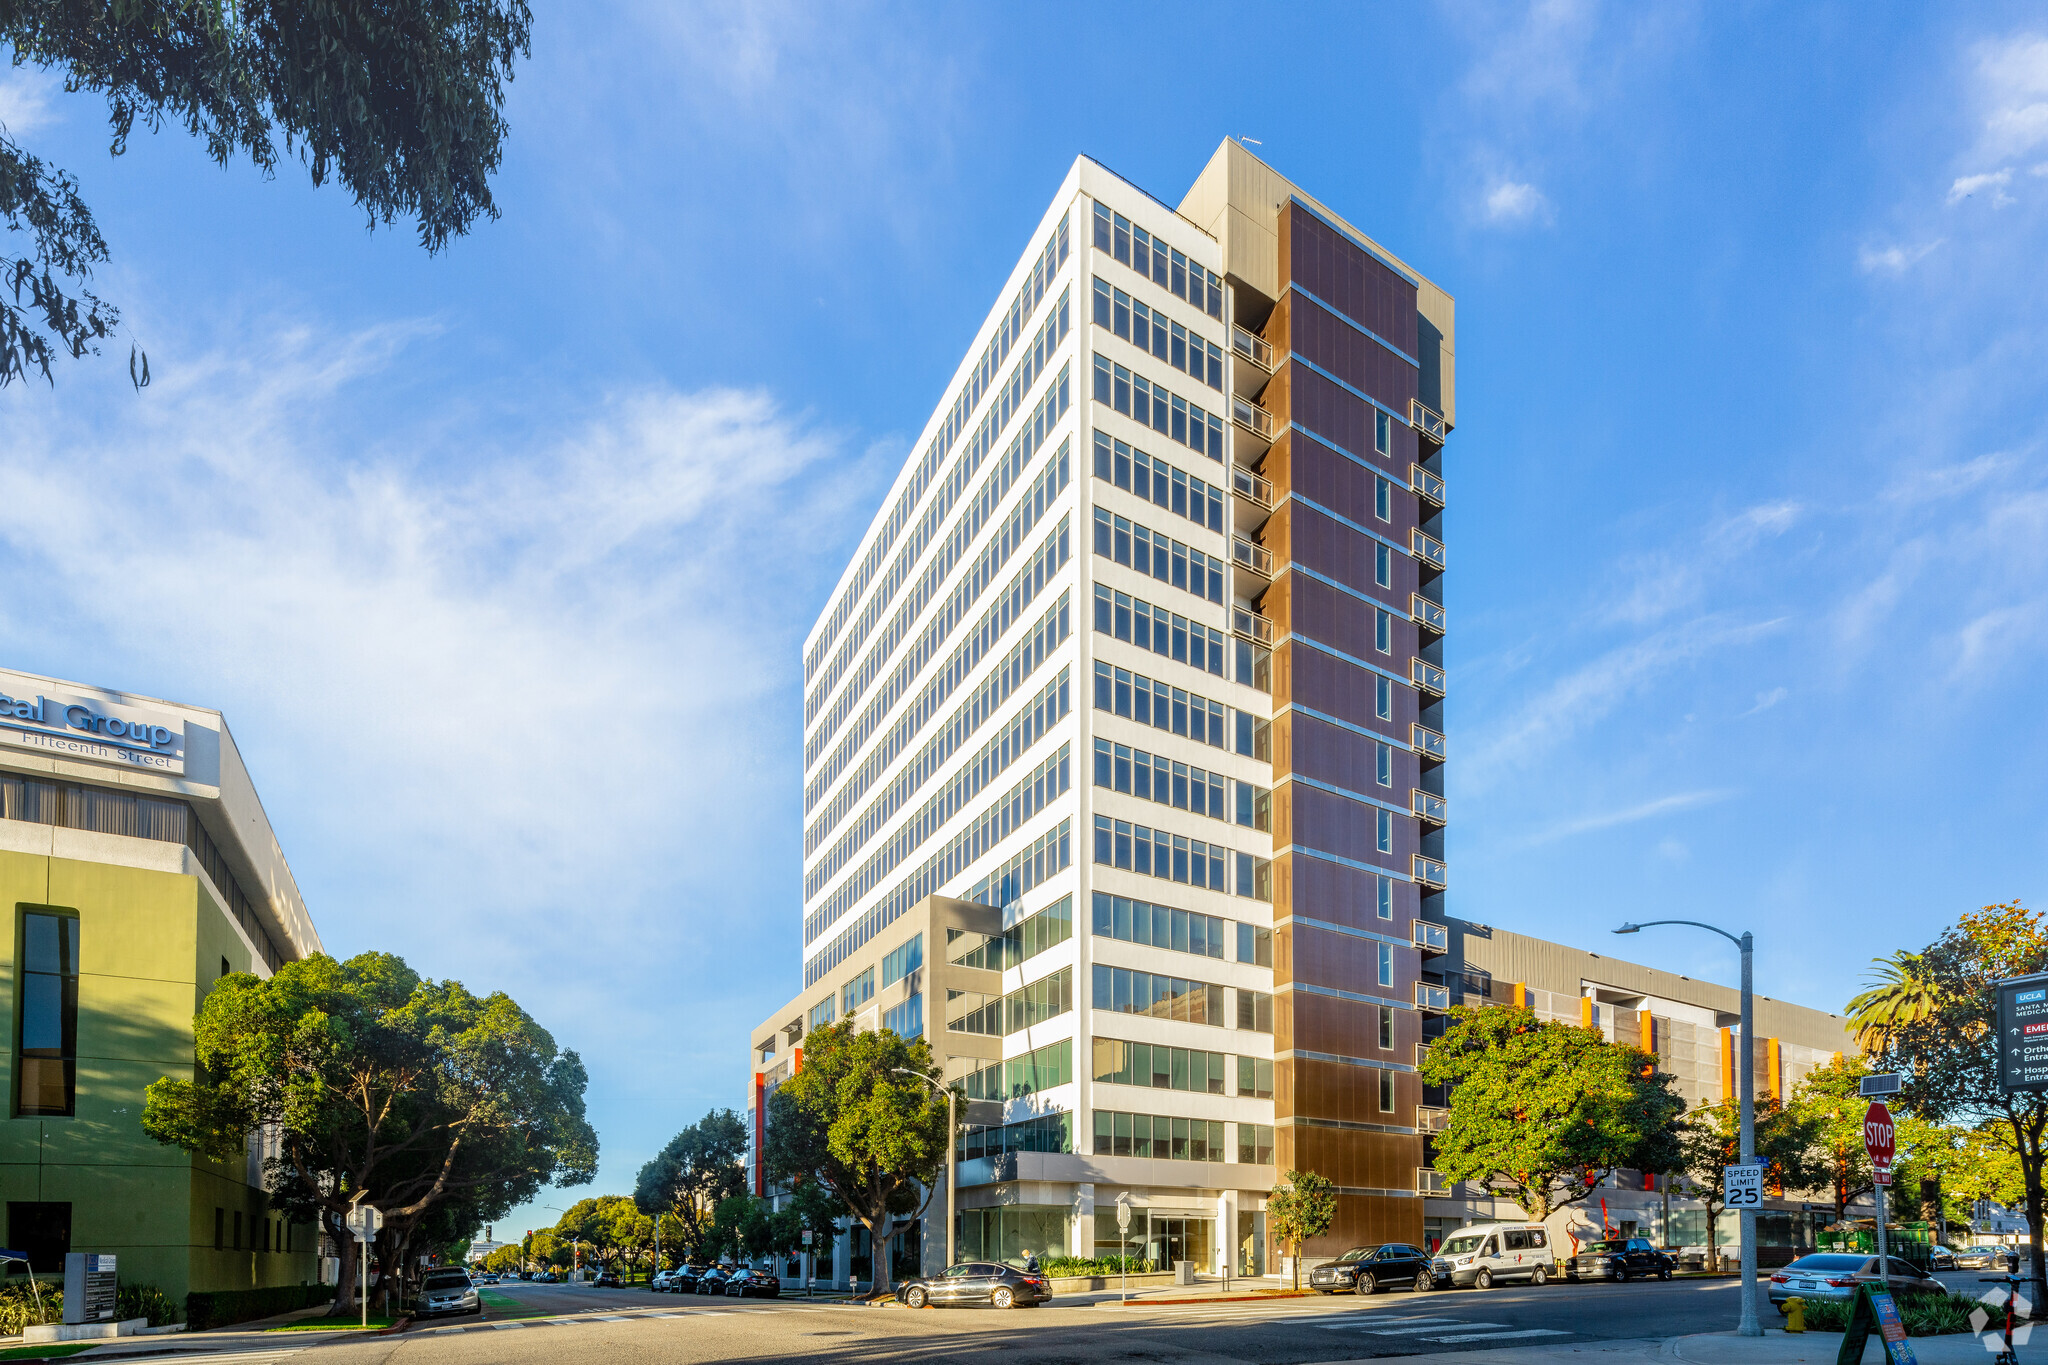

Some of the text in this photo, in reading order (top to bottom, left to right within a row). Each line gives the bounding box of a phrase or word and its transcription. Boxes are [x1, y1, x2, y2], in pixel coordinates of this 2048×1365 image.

[63, 704, 172, 749] Group
[23, 732, 171, 768] Fifteenth Street
[2020, 993, 2042, 1001] UCLA
[2016, 1003, 2040, 1012] SANTA
[2016, 1008, 2048, 1017] MEDICA
[2026, 1024, 2048, 1033] EME
[2024, 1066, 2048, 1074] Hosp
[1867, 1122, 1893, 1148] STOP
[1728, 1169, 1759, 1178] SPEED
[1731, 1178, 1755, 1187] LIMIT
[1729, 1188, 1758, 1204] 25
